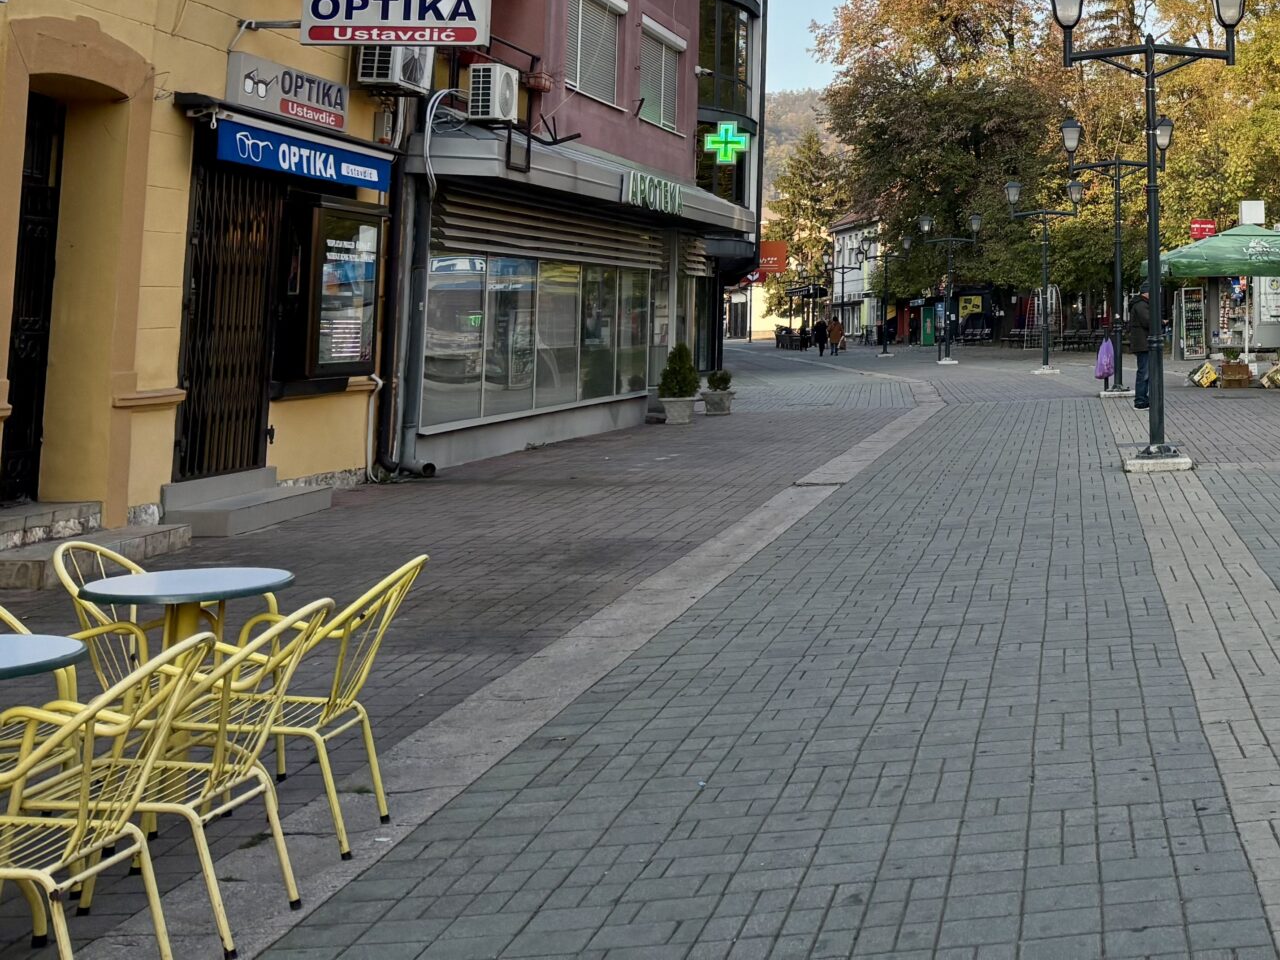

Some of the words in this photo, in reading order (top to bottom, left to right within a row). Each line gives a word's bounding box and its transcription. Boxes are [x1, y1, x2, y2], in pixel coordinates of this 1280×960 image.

[333, 27, 456, 42] Ustavdić
[281, 70, 345, 113] OPTIKA
[288, 102, 336, 126] Ustavdić
[278, 143, 337, 180] OPTIKA
[628, 170, 684, 217] APOTEKA
